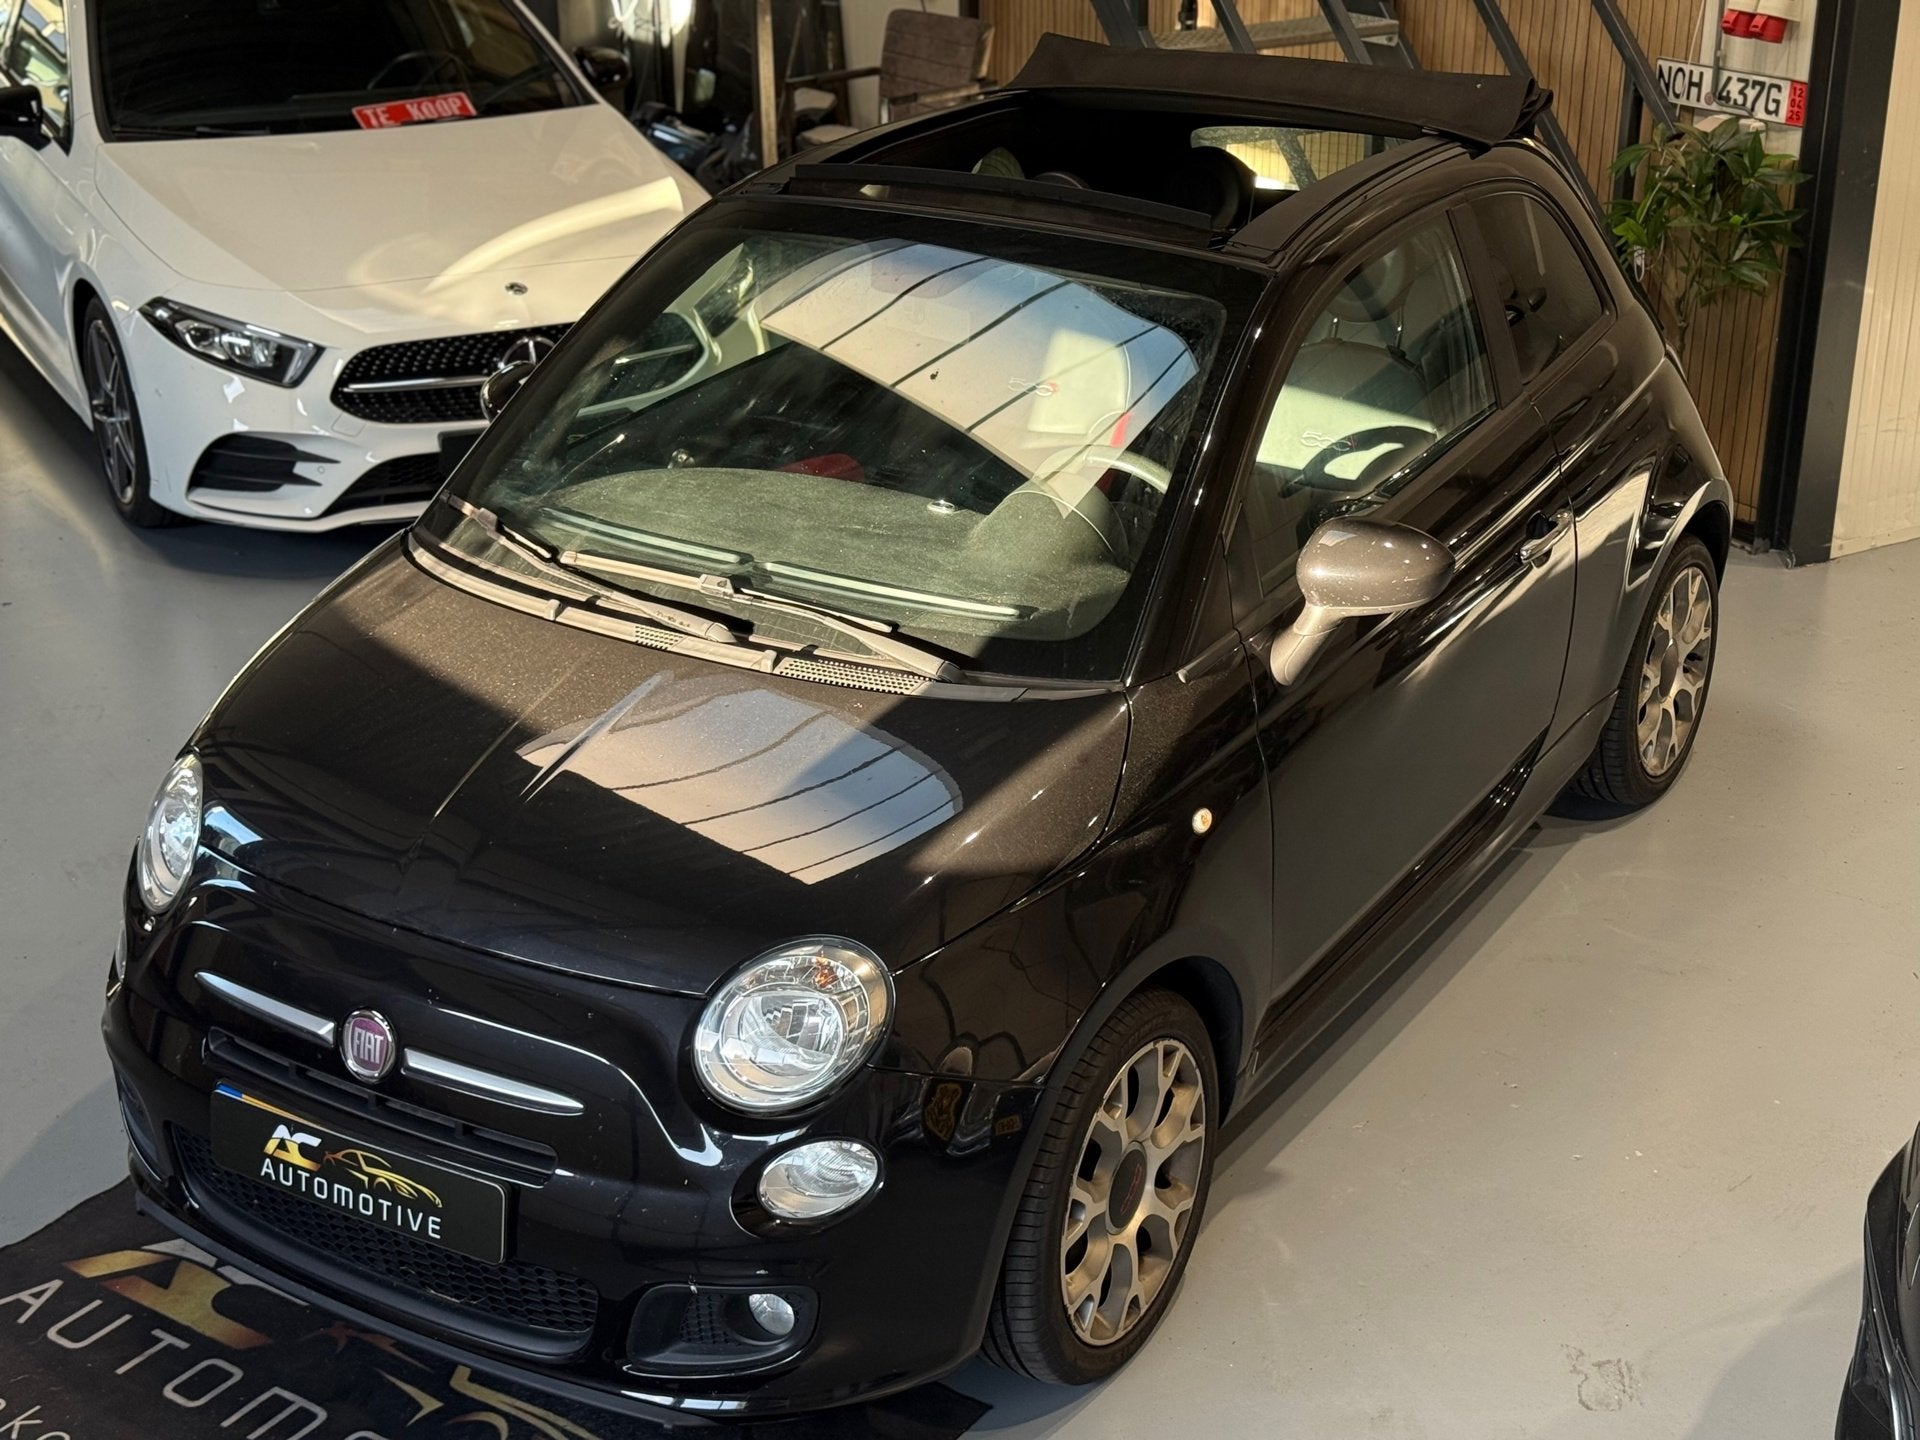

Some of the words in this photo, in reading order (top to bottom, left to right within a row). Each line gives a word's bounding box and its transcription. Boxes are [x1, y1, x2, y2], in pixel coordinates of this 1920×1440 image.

[1717, 75, 1782, 117] 437G
[1792, 86, 1804, 98] 12
[361, 106, 395, 128] TE
[404, 97, 463, 121] KOOP
[1788, 109, 1802, 121] 25
[352, 1026, 384, 1065] FIAT
[260, 1158, 443, 1240] AUTOMOTIVE
